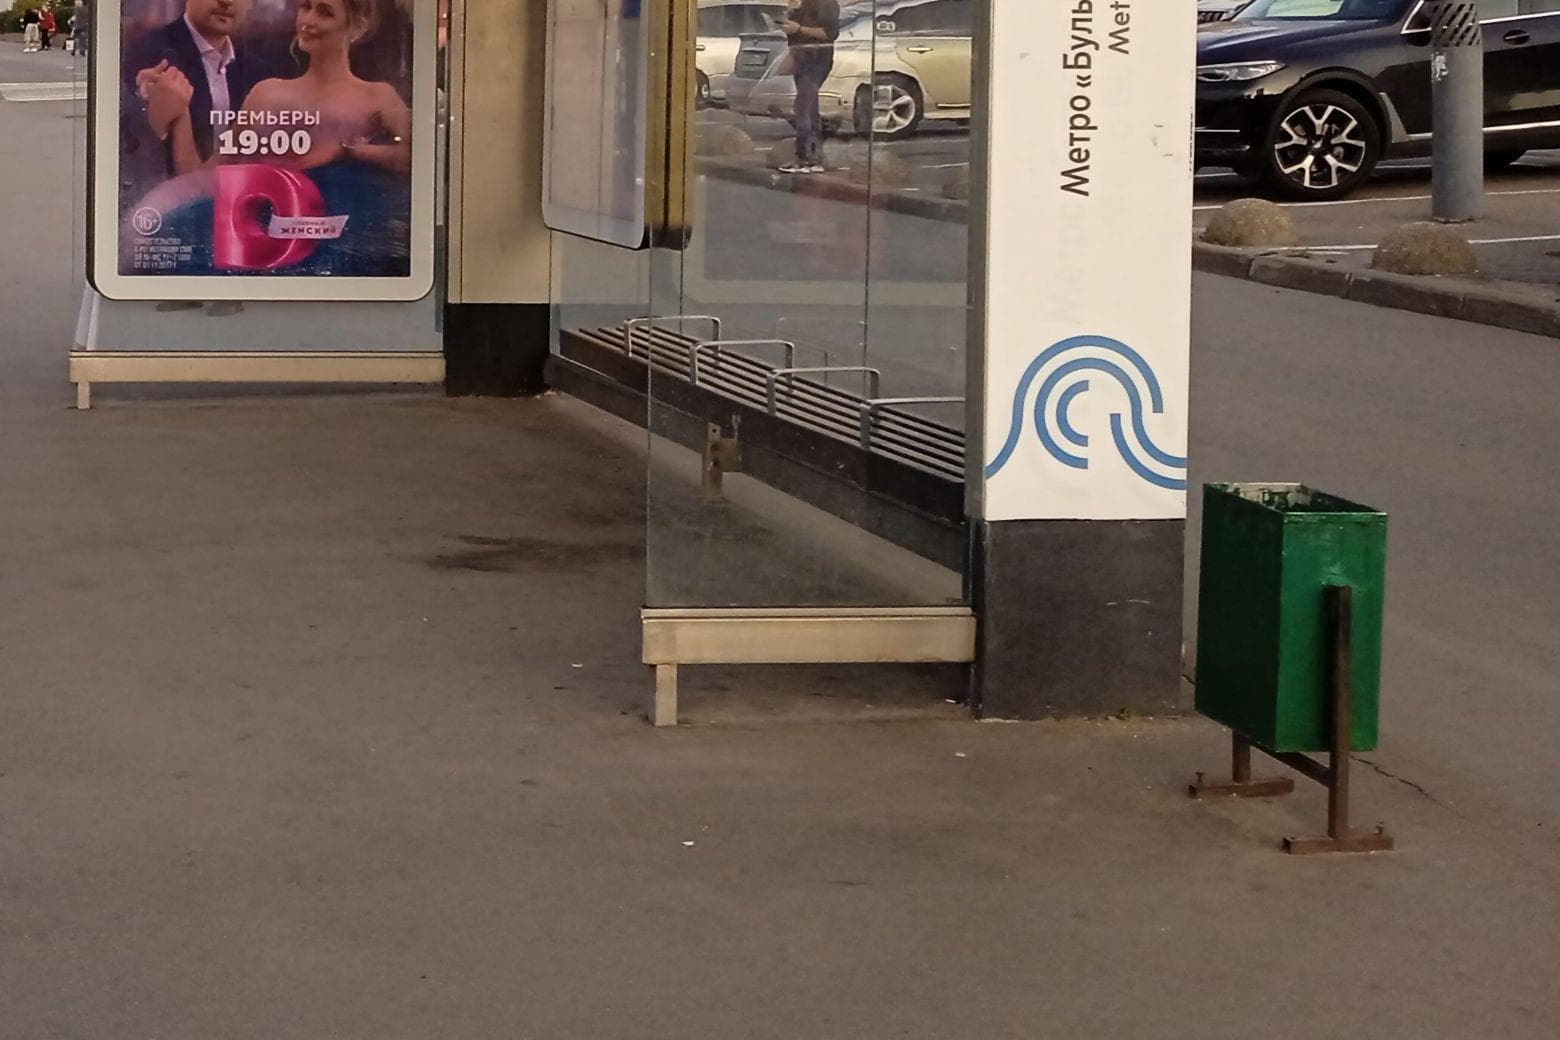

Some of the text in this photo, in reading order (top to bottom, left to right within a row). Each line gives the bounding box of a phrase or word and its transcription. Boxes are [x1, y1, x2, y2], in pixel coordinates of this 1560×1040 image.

[209, 110, 320, 126] ПРЕМЬЕРЫ
[218, 129, 312, 156] 19:00
[1060, 94, 1099, 197] Метро
[280, 225, 337, 235] ЖЕНСКИЙ
